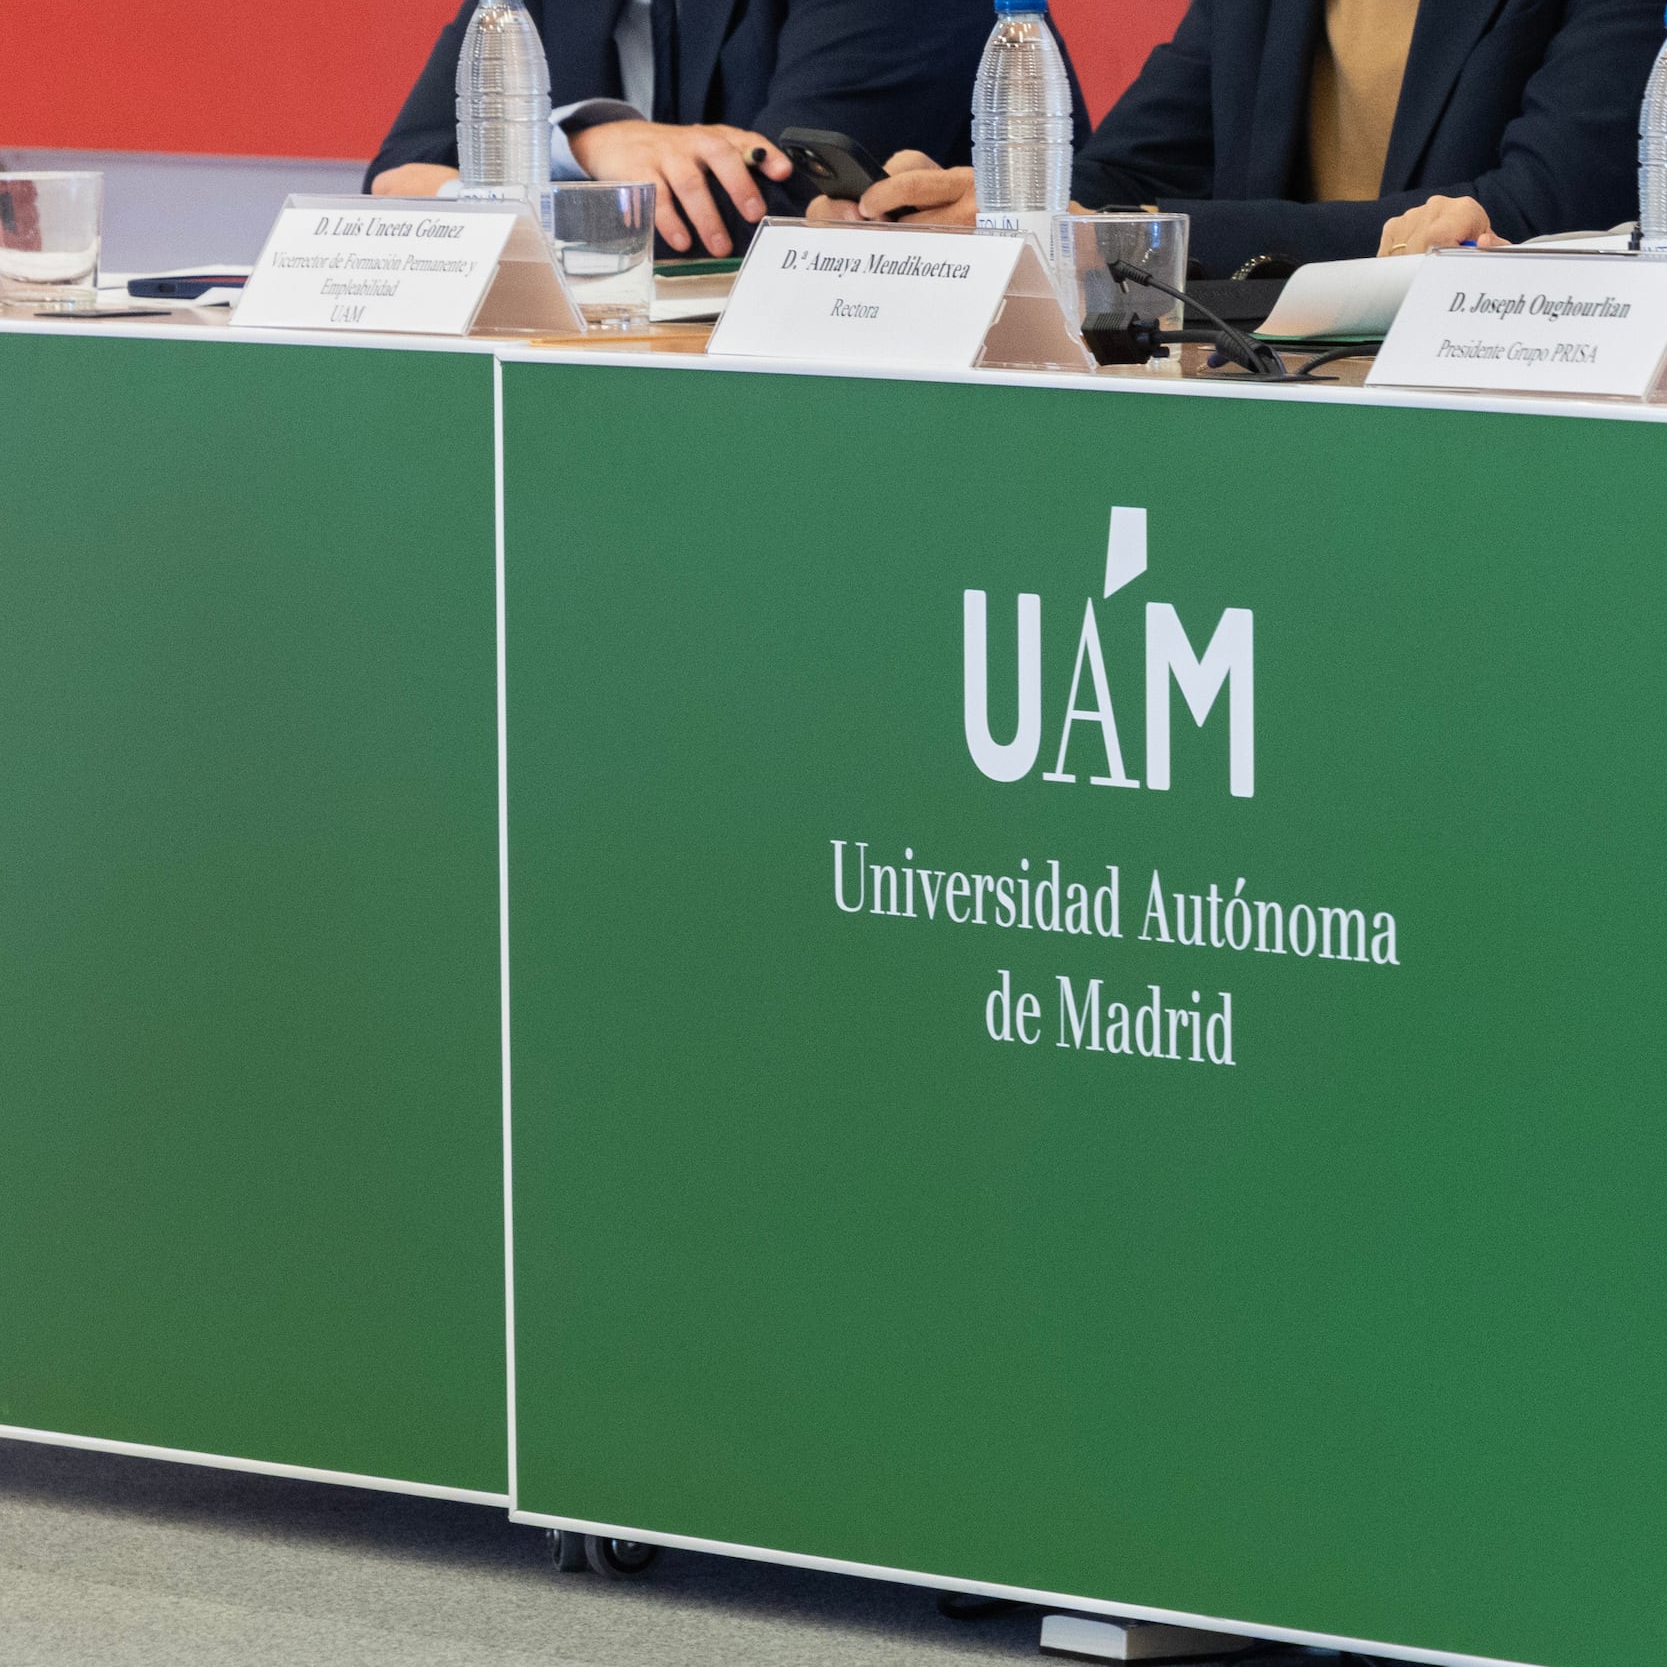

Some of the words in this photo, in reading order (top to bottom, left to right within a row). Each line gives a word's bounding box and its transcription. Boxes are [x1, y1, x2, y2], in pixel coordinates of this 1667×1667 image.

[313, 216, 329, 237] D.
[332, 217, 362, 238] Luis
[366, 217, 411, 238] Unceta
[416, 218, 465, 239] Gómez
[272, 251, 330, 270] Vicerrector
[331, 252, 344, 270] de
[344, 252, 402, 272] Formación
[402, 254, 466, 274] Permanente
[465, 259, 477, 277] y
[807, 251, 861, 278] Amaya
[865, 253, 971, 279] Mendikoetxea
[320, 278, 399, 299] Empleabilidad
[330, 305, 366, 323] UAM
[830, 298, 880, 319] Rectora
[1448, 291, 1466, 313] D.
[1470, 293, 1526, 320] Joseph
[1529, 294, 1631, 321] Oughourlian
[1437, 339, 1505, 361] Presidente
[1506, 341, 1550, 366] Grupo
[1551, 343, 1599, 364] PRISA
[829, 838, 1123, 940] Universidad
[1138, 868, 1400, 966] Autónoma
[985, 969, 1041, 1045] de
[1055, 975, 1236, 1067] Madrid
